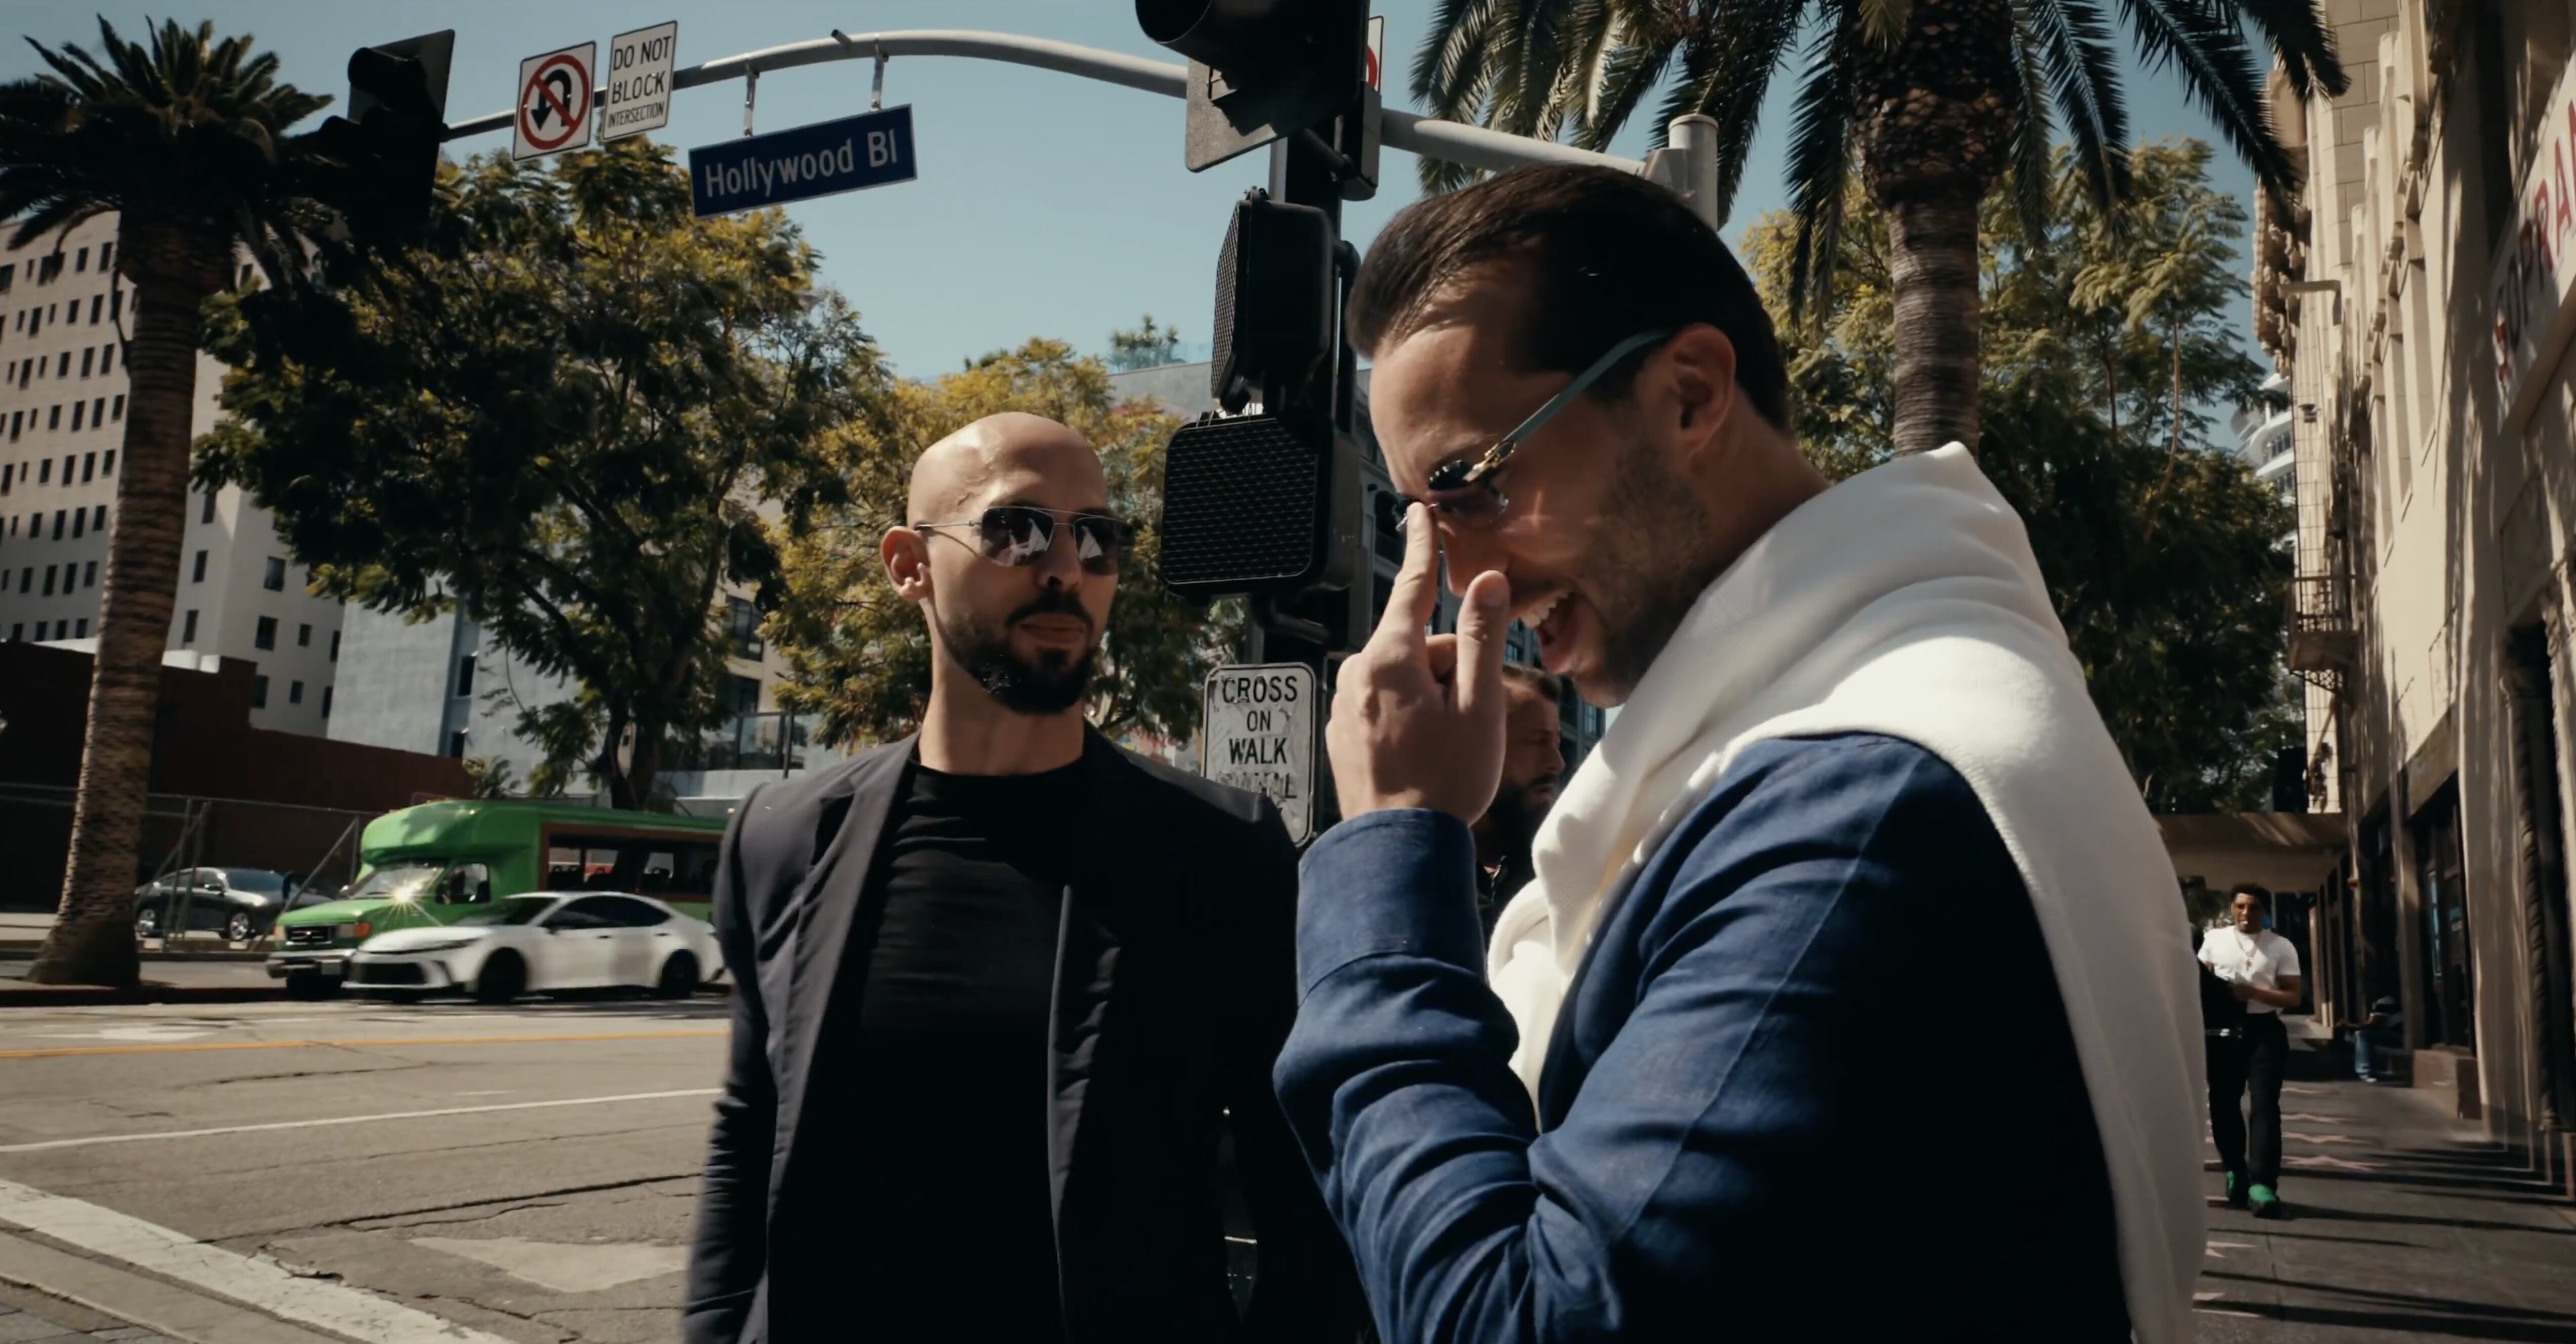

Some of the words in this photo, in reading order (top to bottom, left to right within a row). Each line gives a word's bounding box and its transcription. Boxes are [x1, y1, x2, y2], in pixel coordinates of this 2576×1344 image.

[613, 45, 634, 71] DO
[641, 36, 672, 64] NOT
[612, 70, 666, 104] BLOCK
[608, 102, 664, 129] INTERSECTION
[705, 137, 855, 198] Hollywood
[867, 129, 898, 168] Bl
[1222, 676, 1298, 704] CROSS
[1247, 710, 1271, 732] ON
[1229, 737, 1287, 765] WALK
